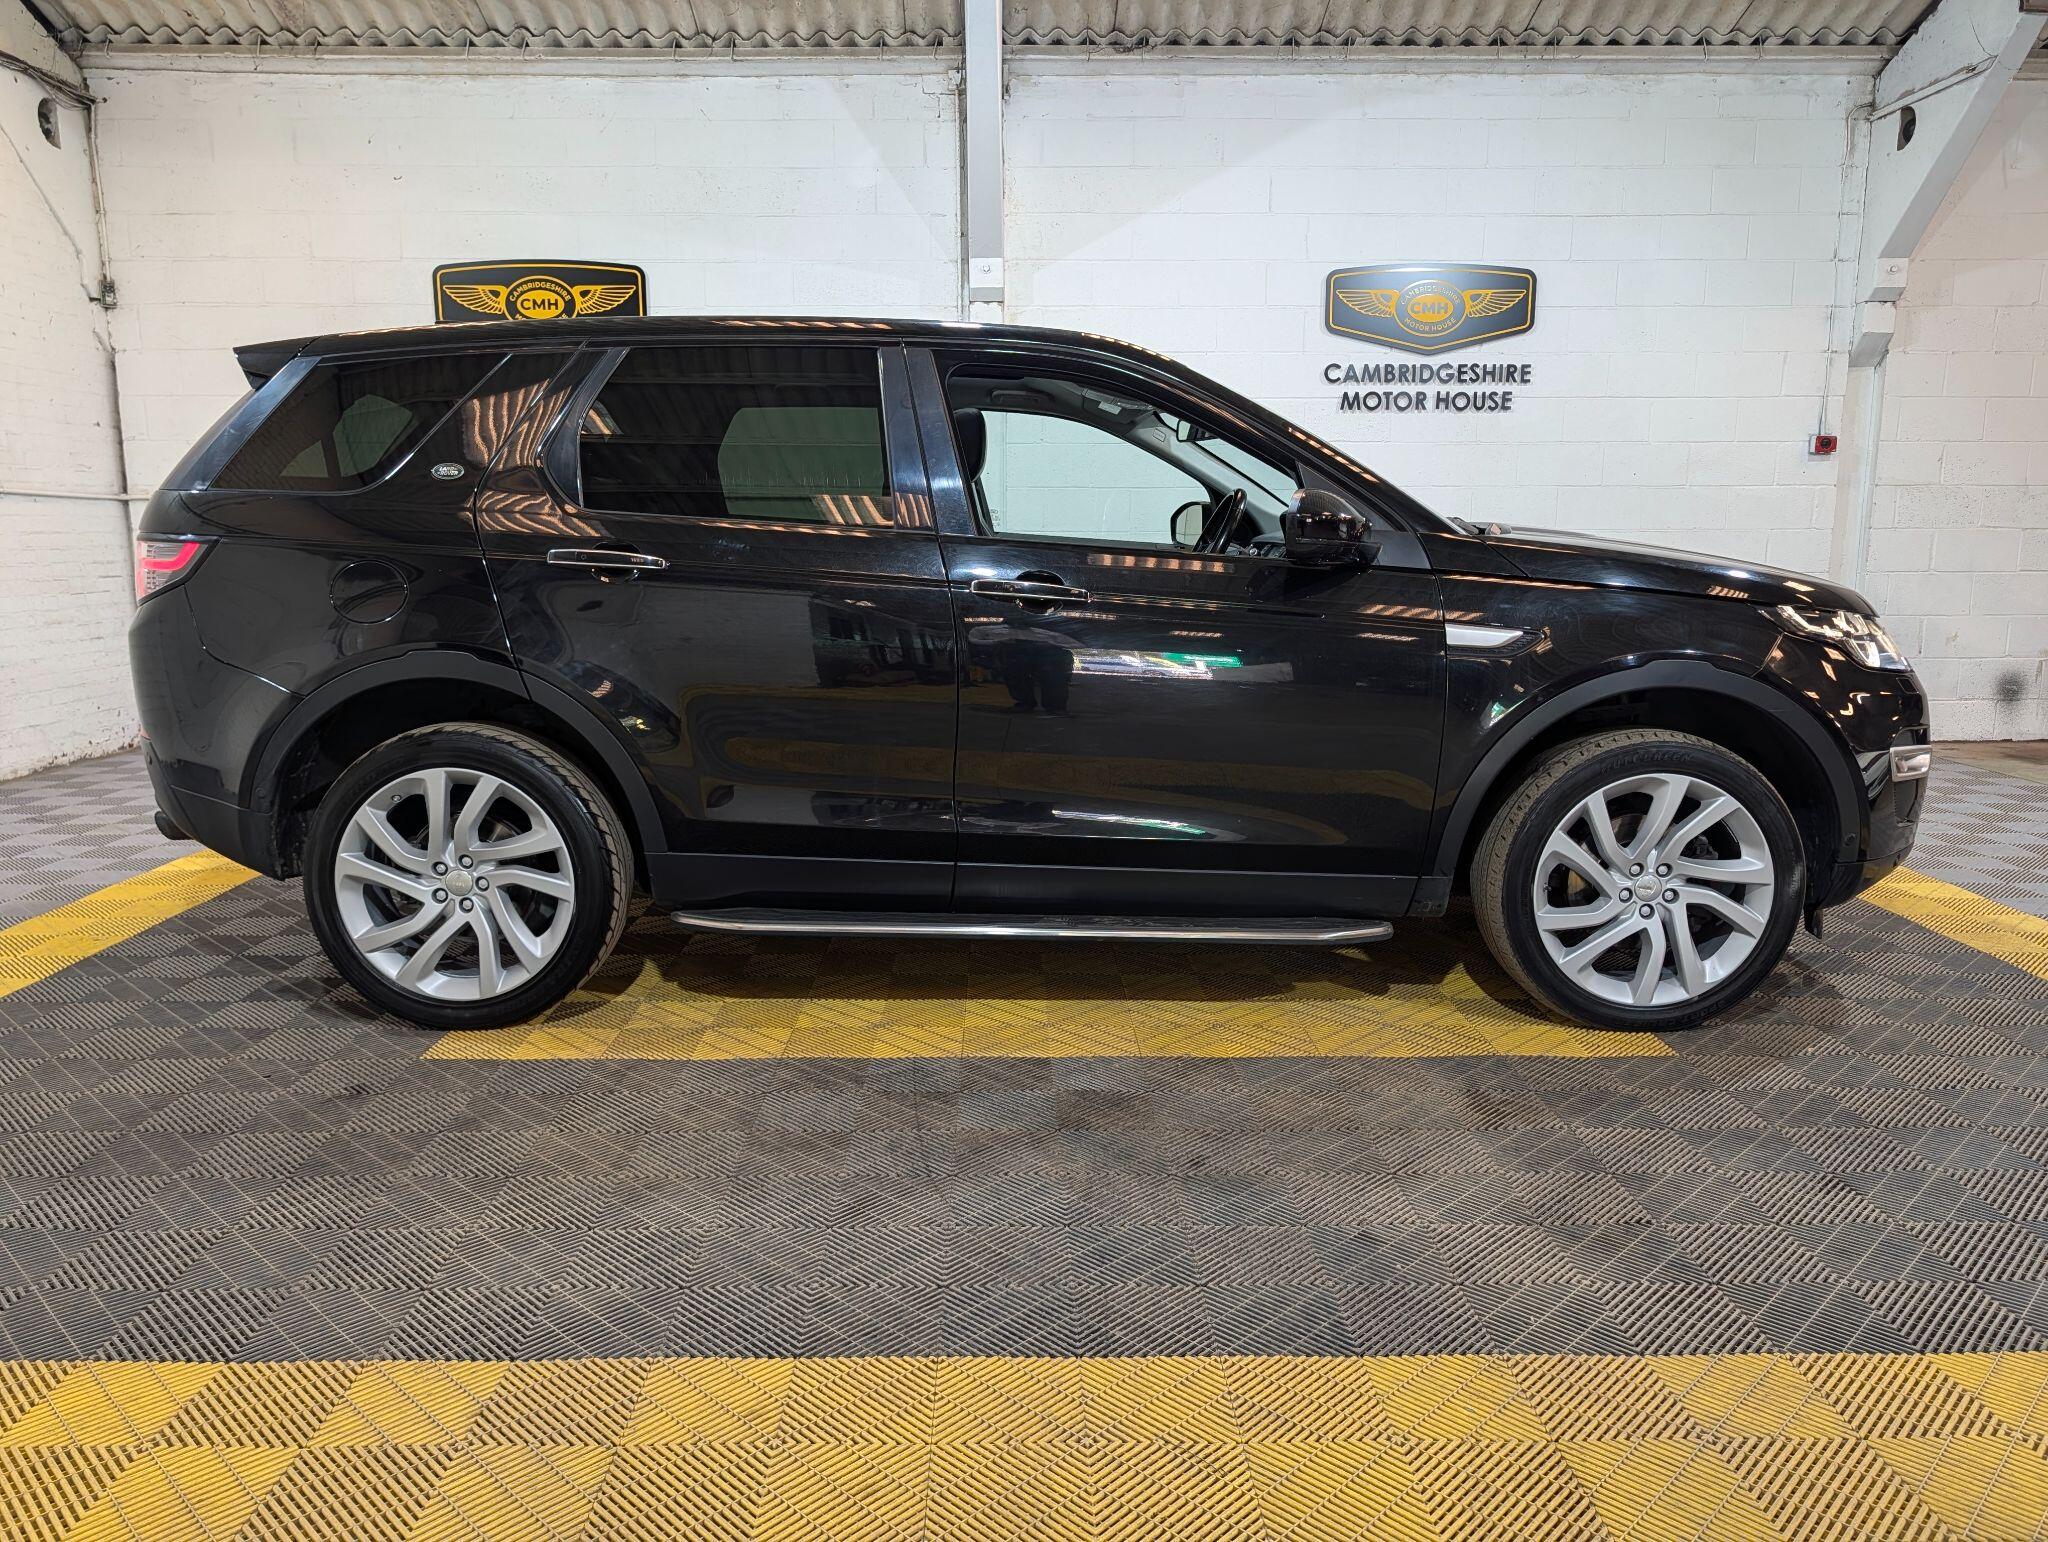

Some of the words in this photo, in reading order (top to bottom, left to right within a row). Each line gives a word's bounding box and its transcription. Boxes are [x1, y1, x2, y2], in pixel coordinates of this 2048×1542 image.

[509, 281, 571, 301] CAMBRIDGESHIRE
[520, 298, 558, 311] CMH
[1411, 302, 1449, 315] CMH
[1404, 317, 1430, 332] MOTOR
[1431, 316, 1457, 332] HOUSE
[1324, 362, 1532, 385] CAMBRIDGESHIRE
[1340, 391, 1427, 412] MOTOR
[1435, 391, 1513, 412] HOUSE
